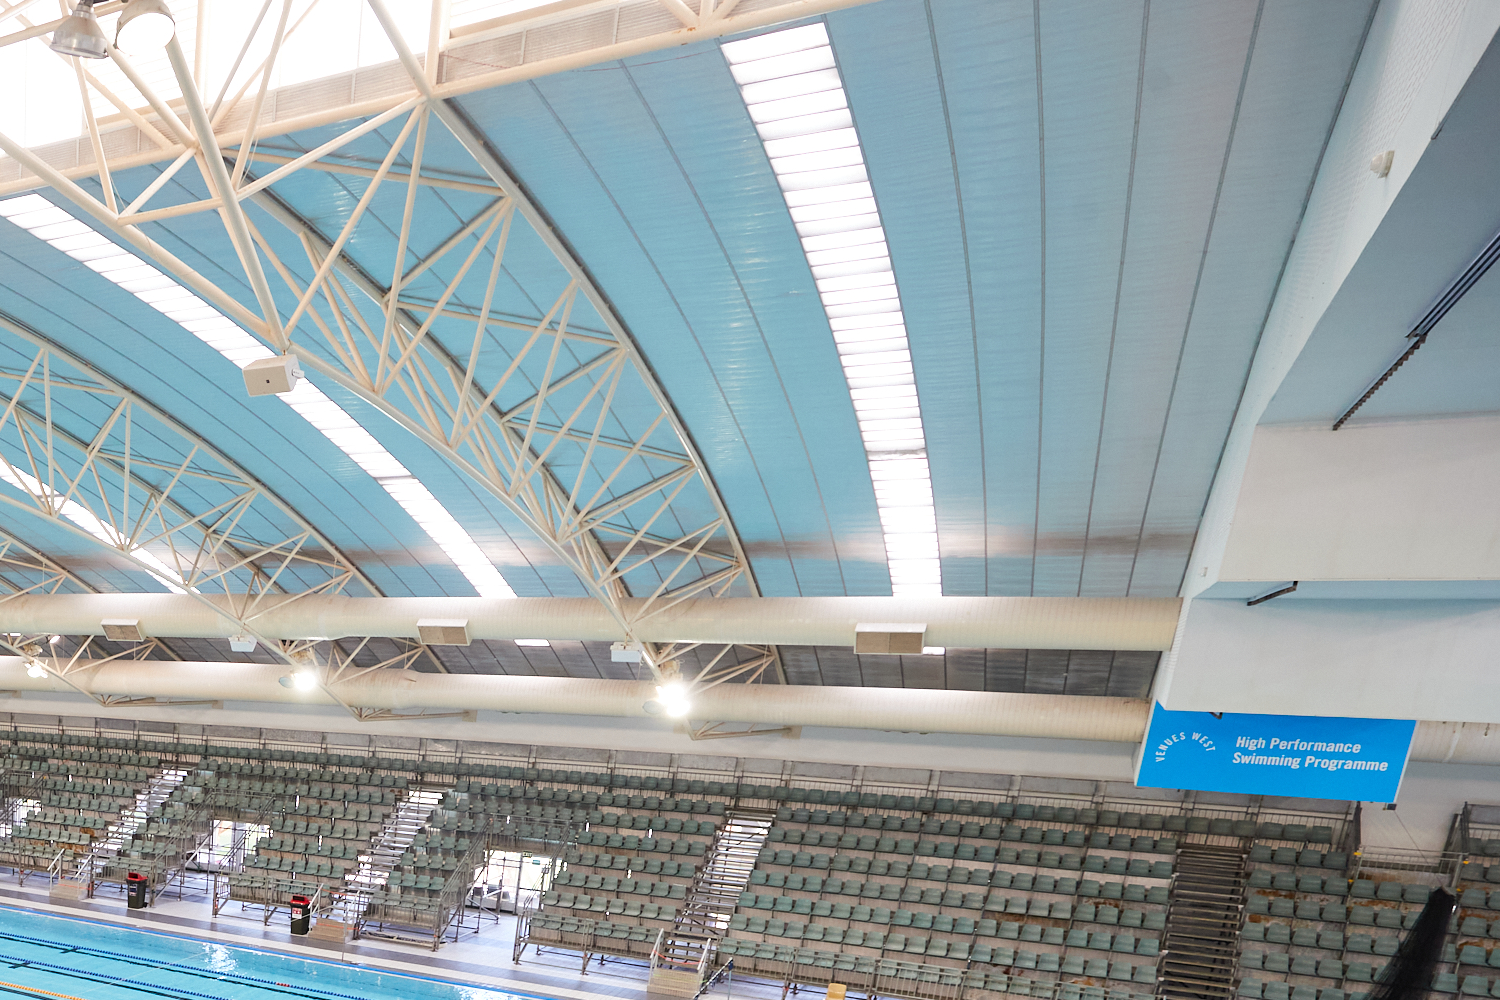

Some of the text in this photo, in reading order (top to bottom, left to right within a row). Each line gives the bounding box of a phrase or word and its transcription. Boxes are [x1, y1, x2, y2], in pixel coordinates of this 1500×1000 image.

[1155, 731, 1216, 762] VENUES WEST
[1236, 736, 1361, 754] High Performance
[1232, 752, 1389, 772] Swimming Programme
